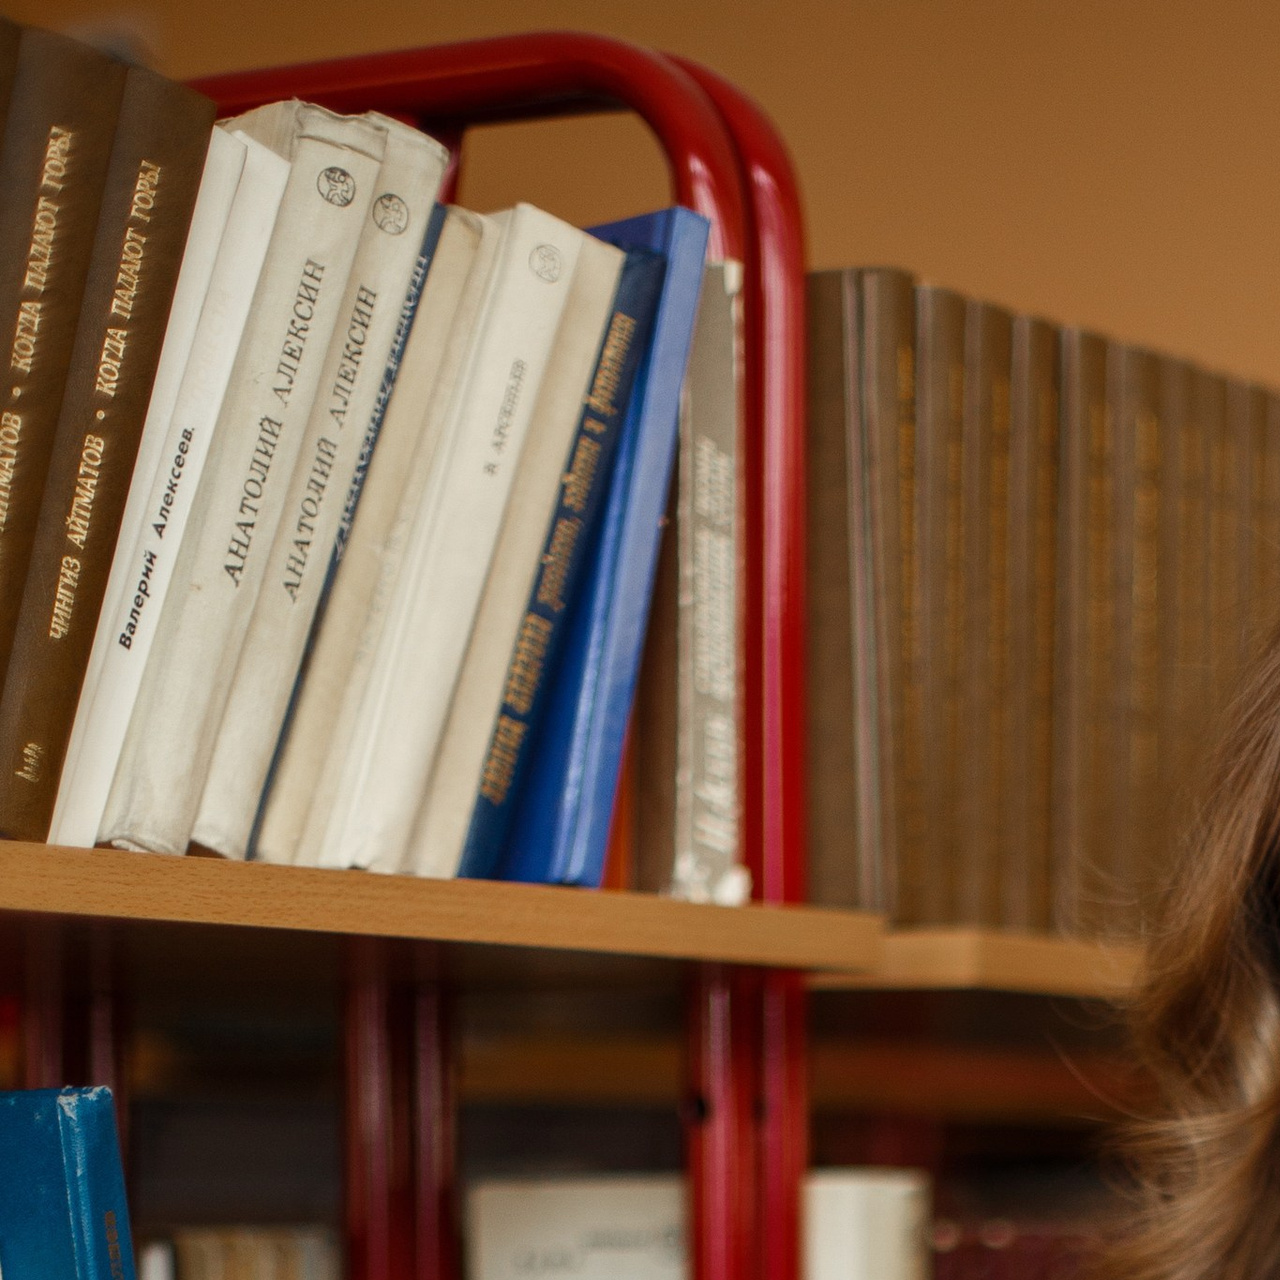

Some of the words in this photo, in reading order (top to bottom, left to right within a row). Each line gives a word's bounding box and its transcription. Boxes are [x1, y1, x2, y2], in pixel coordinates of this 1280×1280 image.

[42, 126, 75, 190] ГОРЫ
[131, 160, 163, 223] ГОРЫ
[24, 197, 60, 291] ПАДАЮТ
[110, 227, 148, 320] ПАДАЮТ
[11, 301, 42, 373] КОГДА
[95, 327, 128, 398] КОГДА
[223, 414, 283, 588] АНАТОЛИЙ
[272, 258, 326, 408] АЛЕКСИН
[282, 437, 339, 604] АНАТОЛИЙ
[328, 285, 378, 429] АЛЕКСИН
[65, 433, 105, 550] АЙТМАТОВ
[118, 549, 158, 651] Валерий
[156, 427, 196, 539] Алексеев.
[49, 555, 82, 642] ЧИНГИЗ
